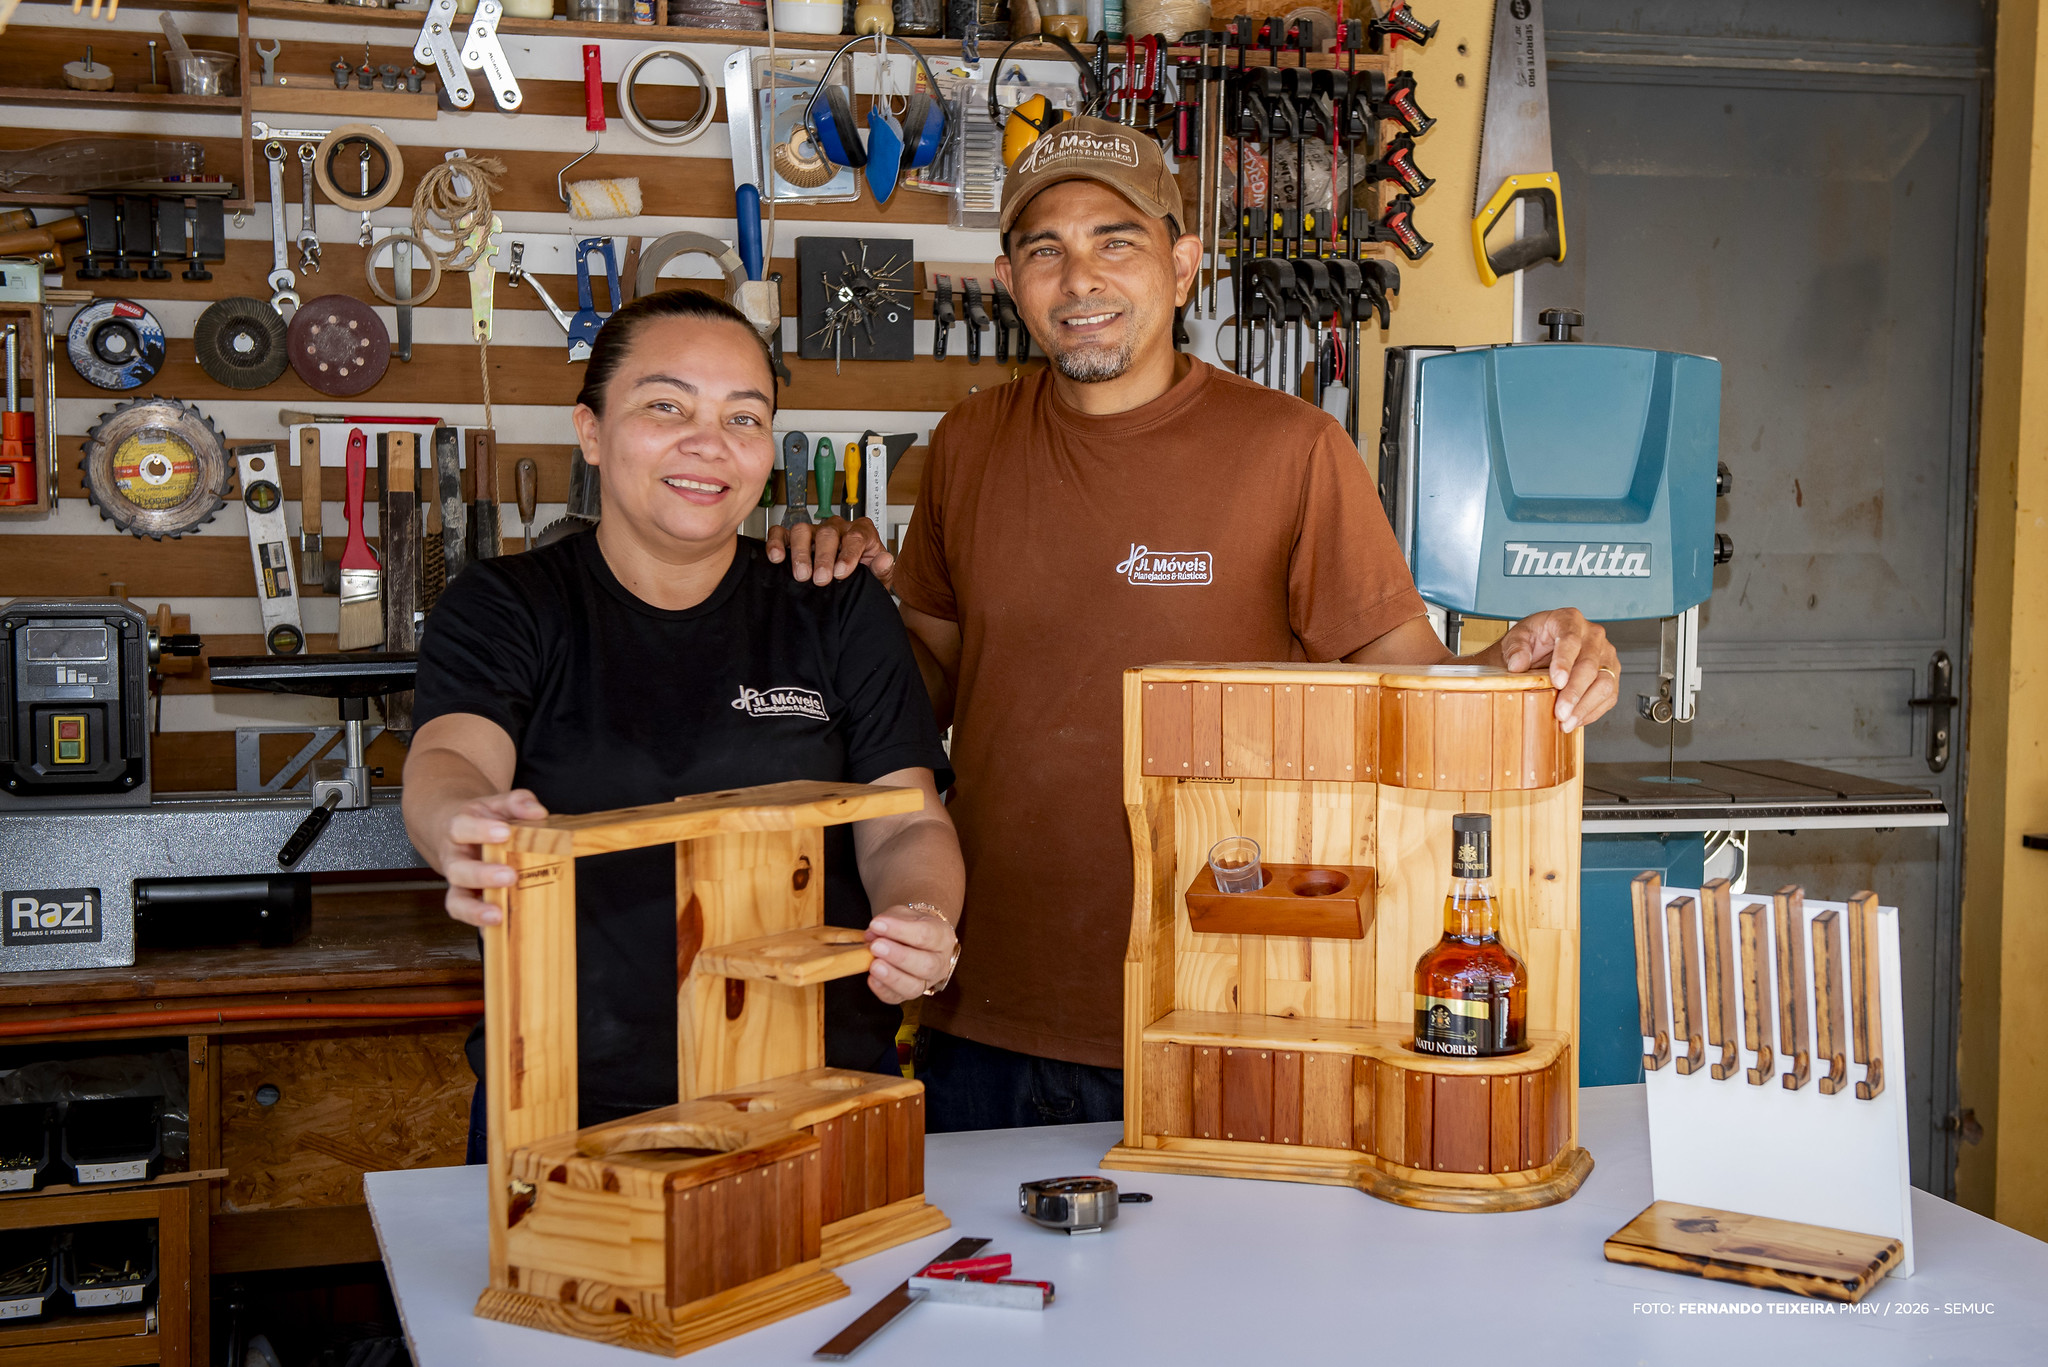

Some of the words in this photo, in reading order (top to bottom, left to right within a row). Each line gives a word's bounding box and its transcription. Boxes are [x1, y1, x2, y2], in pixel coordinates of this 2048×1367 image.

[1526, 24, 1535, 66] SERROTE
[1527, 68, 1536, 88] PRO
[1059, 134, 1131, 154] Móveis
[1242, 147, 1266, 208] WORKE
[1135, 558, 1150, 571] JL
[1153, 556, 1206, 572] Móveis
[1505, 543, 1650, 576] makita
[1133, 572, 1170, 582] Planejados
[1171, 572, 1178, 580] &
[1177, 571, 1207, 580] Rústicos
[752, 697, 770, 707] JL
[770, 691, 821, 710] Móveis
[12, 895, 93, 929] Razi
[50, 928, 93, 936] FERRAMENTAS
[1415, 1036, 1435, 1052] NATU
[1436, 1042, 1478, 1056] NOBILIS
[81, 1168, 106, 1180] 3,5
[121, 1164, 141, 1175] 35
